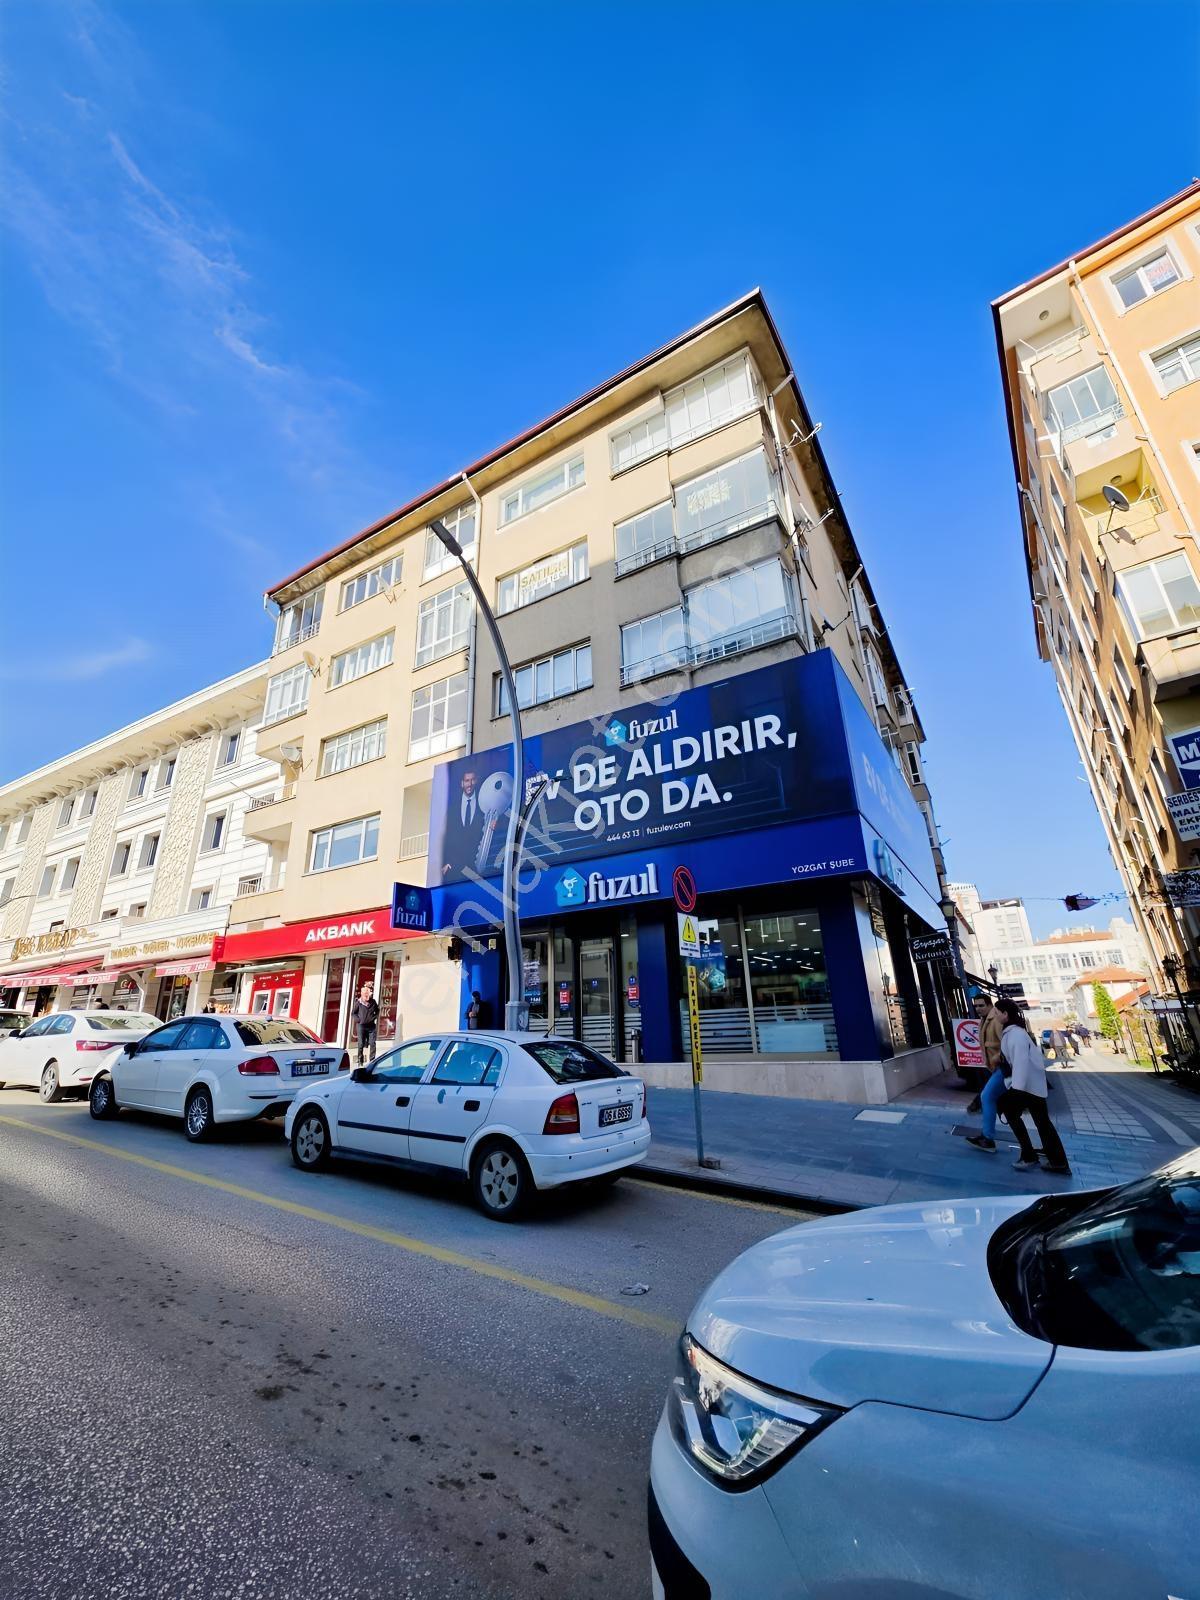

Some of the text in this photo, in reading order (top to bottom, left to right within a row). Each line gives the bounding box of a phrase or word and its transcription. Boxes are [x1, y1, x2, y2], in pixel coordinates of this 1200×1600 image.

[629, 709, 679, 741] fuzul
[574, 756, 616, 794] DE
[627, 714, 797, 781] ALDIRIR,
[574, 773, 732, 831] OTO DA.
[607, 821, 691, 842] 444 63 13 fuzulev.com
[792, 862, 827, 873] YOZGAT
[588, 863, 659, 903] fuzul
[395, 906, 426, 927] fuzul
[305, 921, 375, 943] AKBANK
